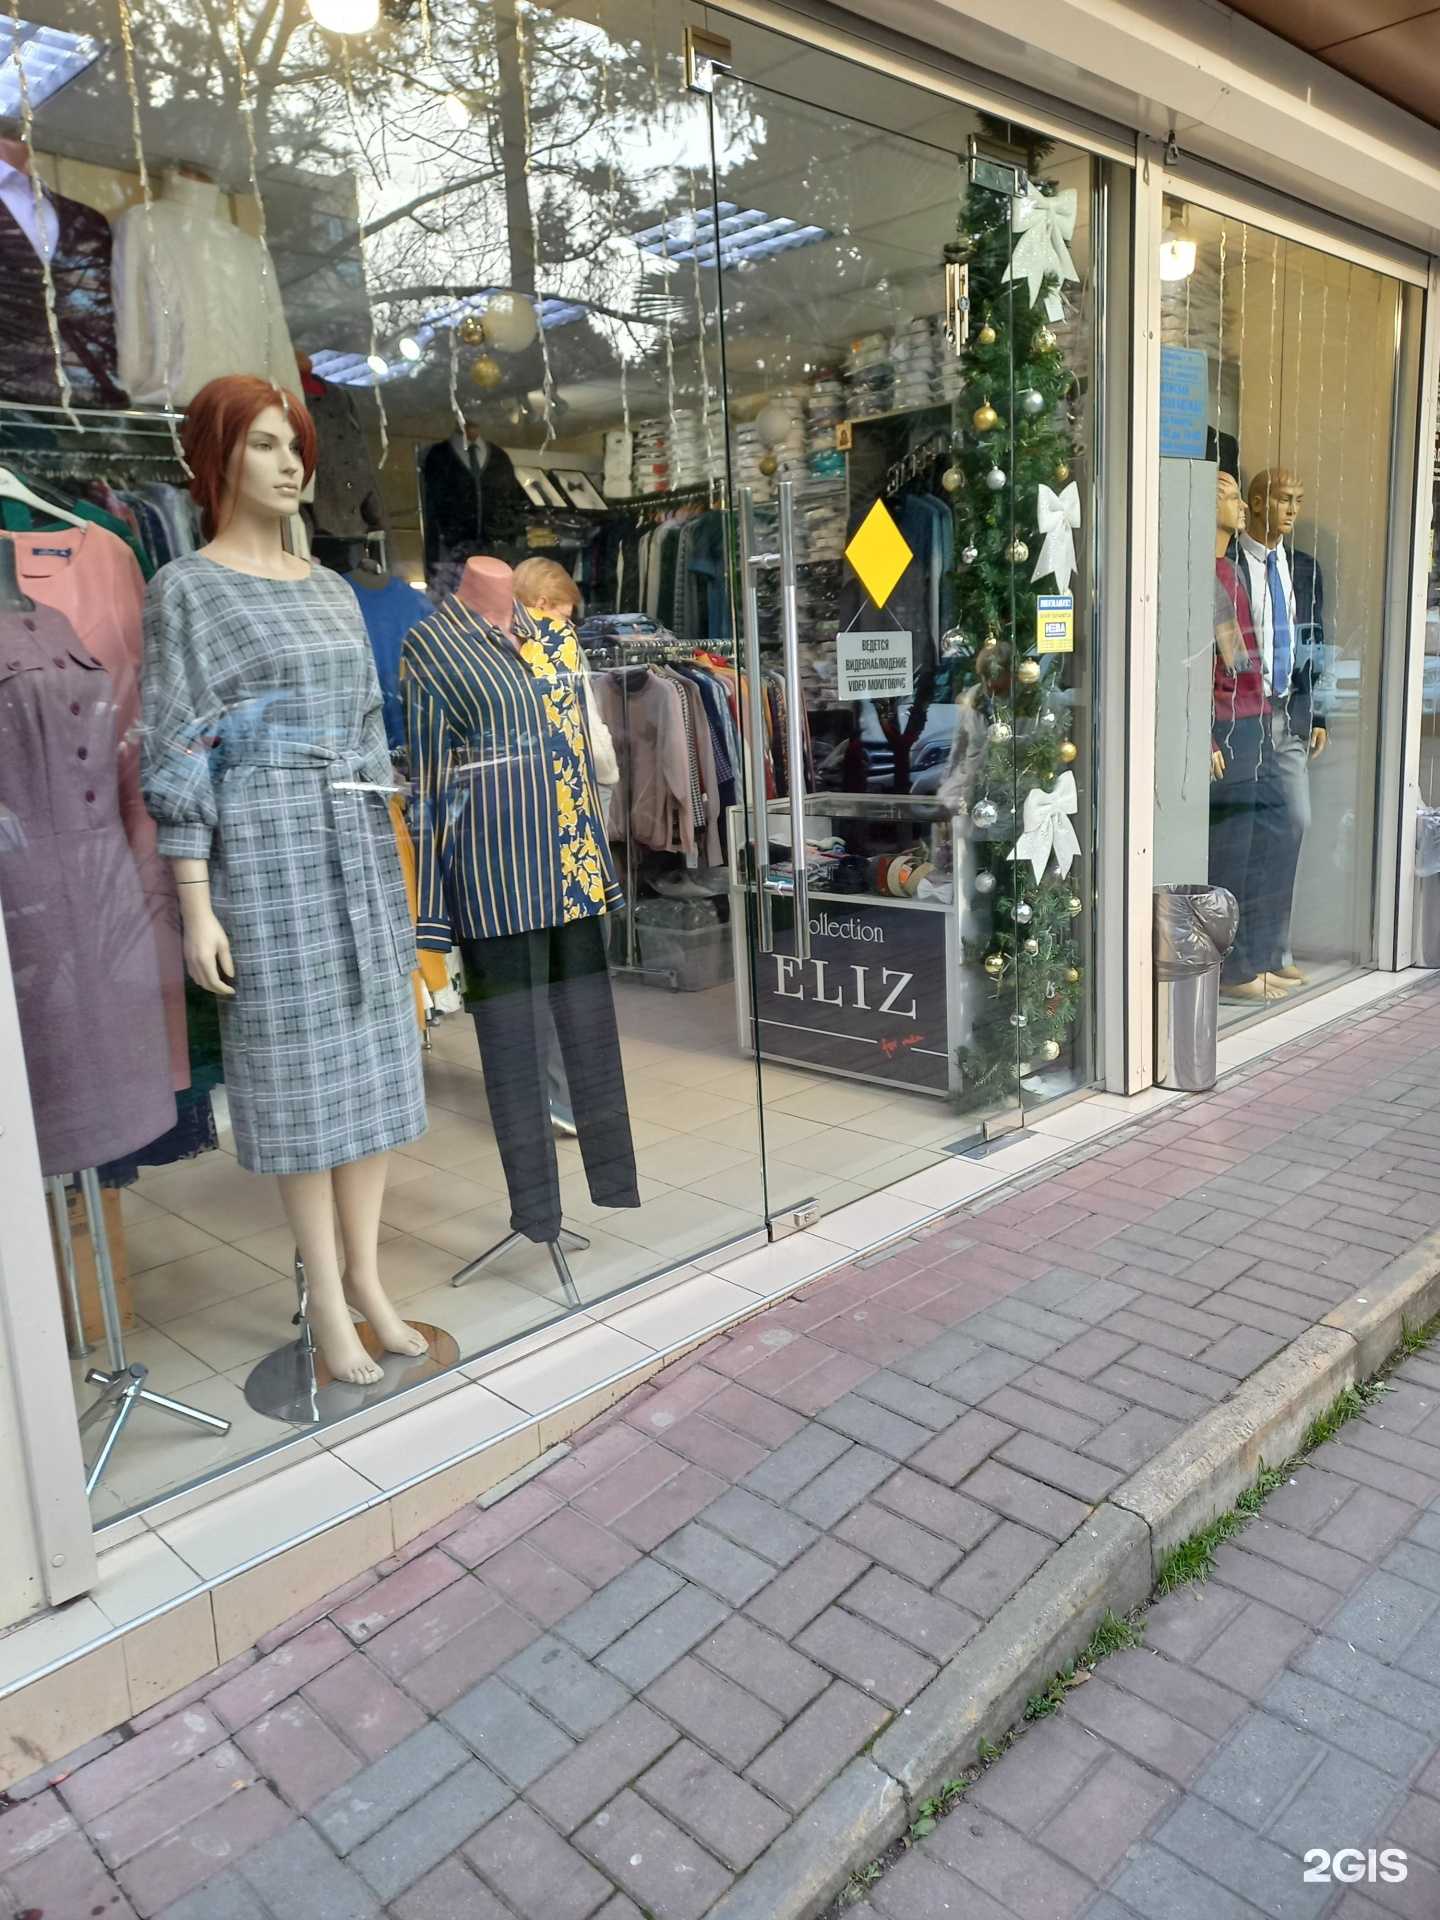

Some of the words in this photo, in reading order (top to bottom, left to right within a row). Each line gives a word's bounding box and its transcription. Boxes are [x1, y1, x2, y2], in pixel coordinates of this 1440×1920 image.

[861, 639, 889, 653] ВЕДЕТСЯ
[845, 657, 907, 672] ВИДЕОНАБЛЮДЕНИЕ
[848, 679, 867, 692] VIDEO
[807, 912, 885, 943] ollection
[770, 953, 917, 1020] ELIZ
